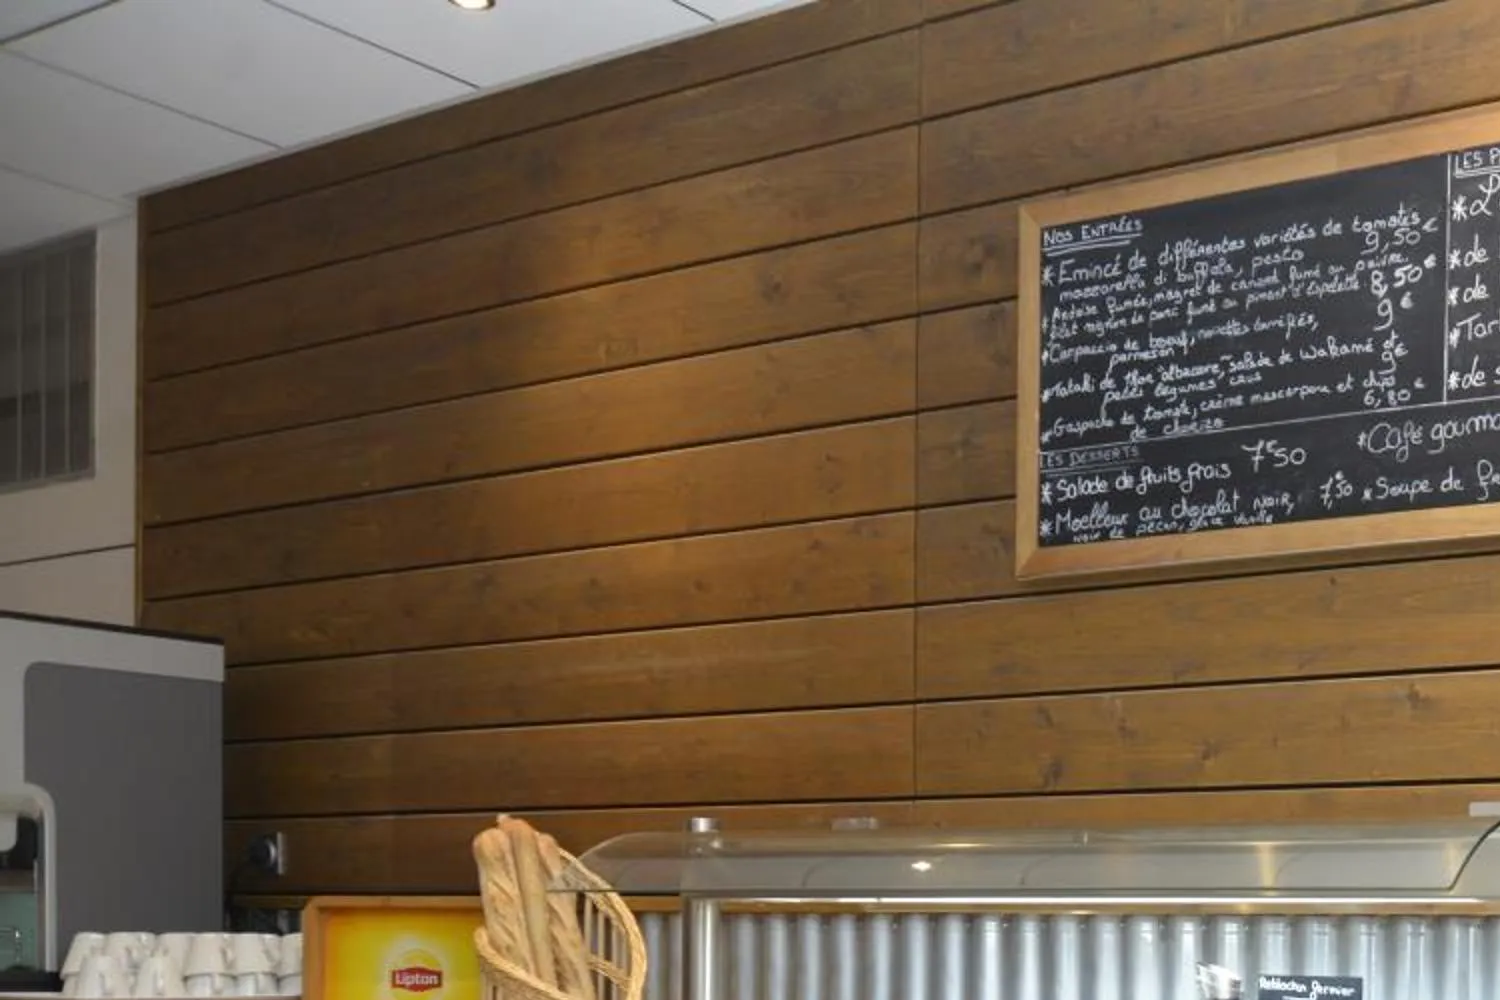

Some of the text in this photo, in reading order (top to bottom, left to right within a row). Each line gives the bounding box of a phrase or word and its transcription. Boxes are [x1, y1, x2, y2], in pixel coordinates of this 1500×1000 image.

[1128, 249, 1147, 272] de
[1321, 215, 1343, 237] de
[1464, 234, 1489, 267] de
[1463, 273, 1489, 302] de
[1462, 355, 1486, 389] de
[1440, 466, 1464, 493] de
[395, 971, 438, 988] Lipton
